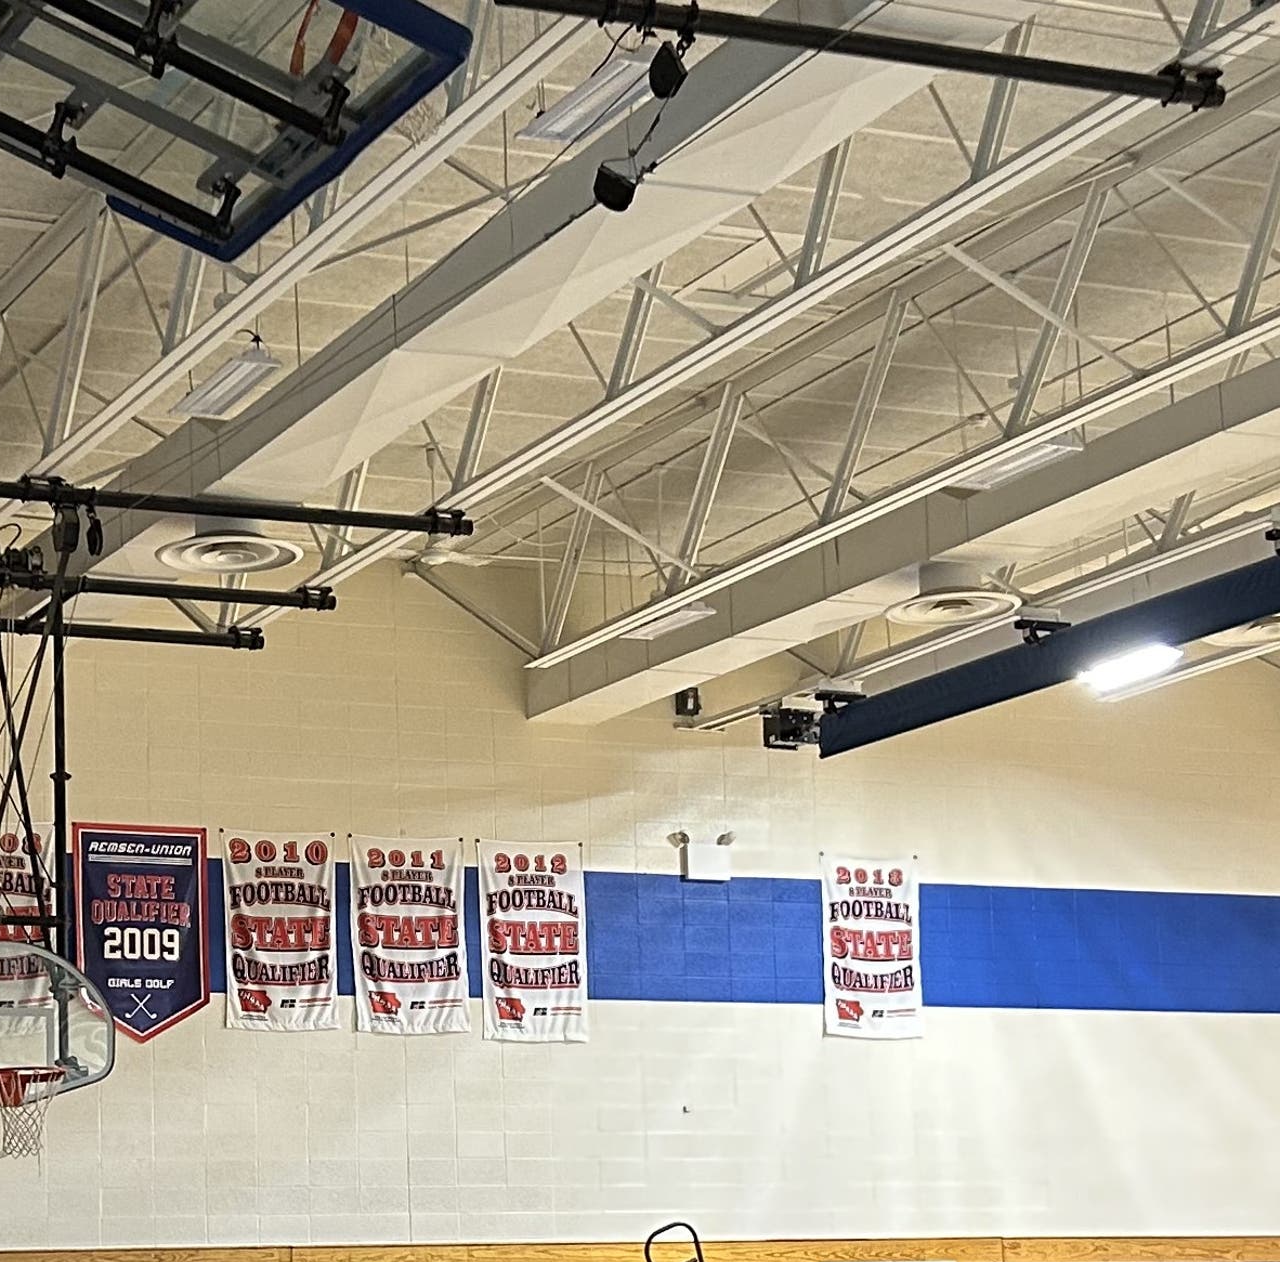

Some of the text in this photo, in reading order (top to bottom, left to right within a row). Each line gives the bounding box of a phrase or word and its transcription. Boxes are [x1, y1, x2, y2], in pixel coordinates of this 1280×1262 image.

[88, 841, 192, 856] REMSEN-UNION
[229, 838, 328, 866] 2010
[368, 848, 445, 870] 2011
[264, 866, 304, 879] PLAYER
[391, 870, 433, 882] PLAYER
[495, 852, 567, 874] 2012
[107, 874, 175, 900] STATE
[516, 874, 556, 887] PLAYER
[856, 886, 892, 898] PLAYER
[230, 881, 330, 912] FOOTBALL
[358, 884, 456, 912] FOOTBALL
[487, 888, 578, 918] FOOTBALL
[91, 900, 192, 928] QUALIFIER
[829, 900, 912, 926] FOOTBALL
[104, 928, 180, 960] 2009
[230, 914, 330, 952] STATE
[358, 912, 458, 950] STATE
[488, 918, 579, 955] STATE
[830, 926, 913, 961] STATE
[232, 952, 330, 986] QUALIFIER
[361, 950, 461, 983] QUALIFIER
[490, 958, 582, 990] QUALIFIER
[832, 962, 914, 992] QUALIFIER
[108, 978, 174, 990] GIRLS GOLF
